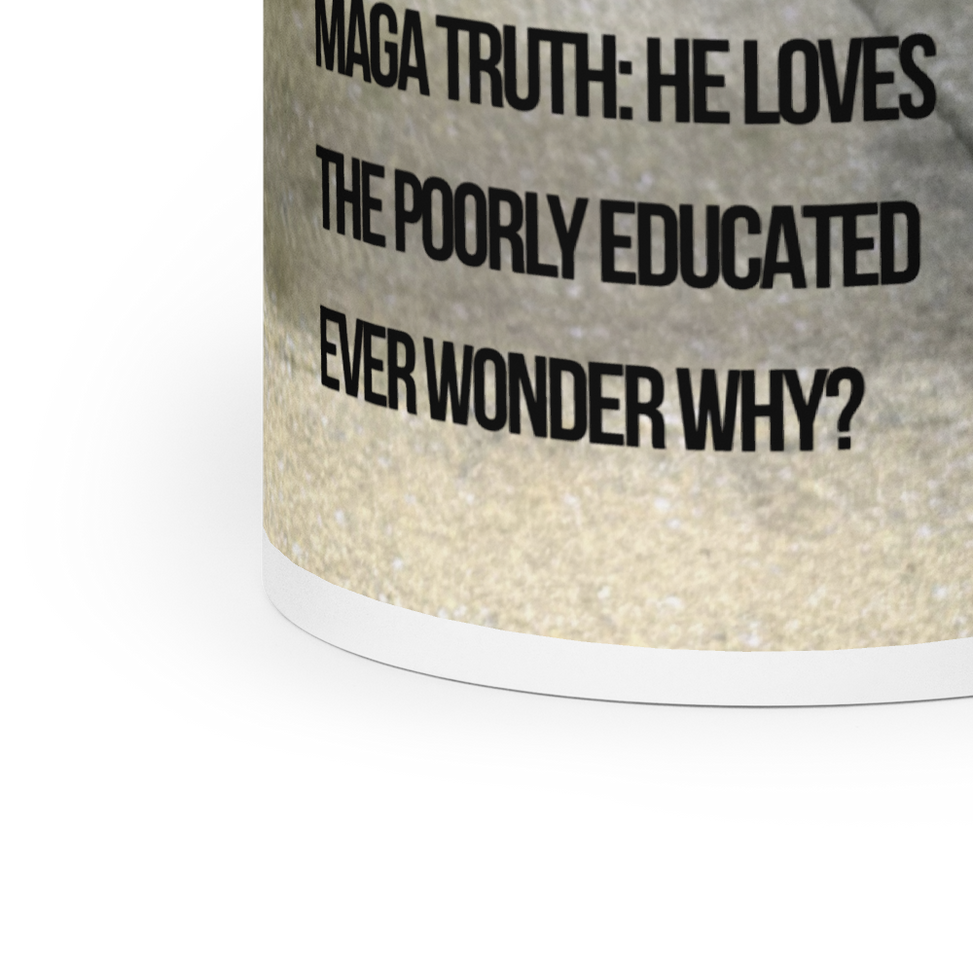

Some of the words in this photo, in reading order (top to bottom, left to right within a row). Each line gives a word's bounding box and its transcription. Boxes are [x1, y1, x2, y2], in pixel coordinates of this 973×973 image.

[436, 15, 633, 120] TRUTH:
[647, 37, 730, 124] HE
[743, 33, 936, 124] LOVES
[316, 144, 386, 248] THE
[394, 169, 589, 279] POORLY
[600, 200, 920, 289] EDUCATED
[320, 305, 417, 414] EVER
[423, 336, 666, 448] WONDER
[676, 366, 865, 451] WHY?
